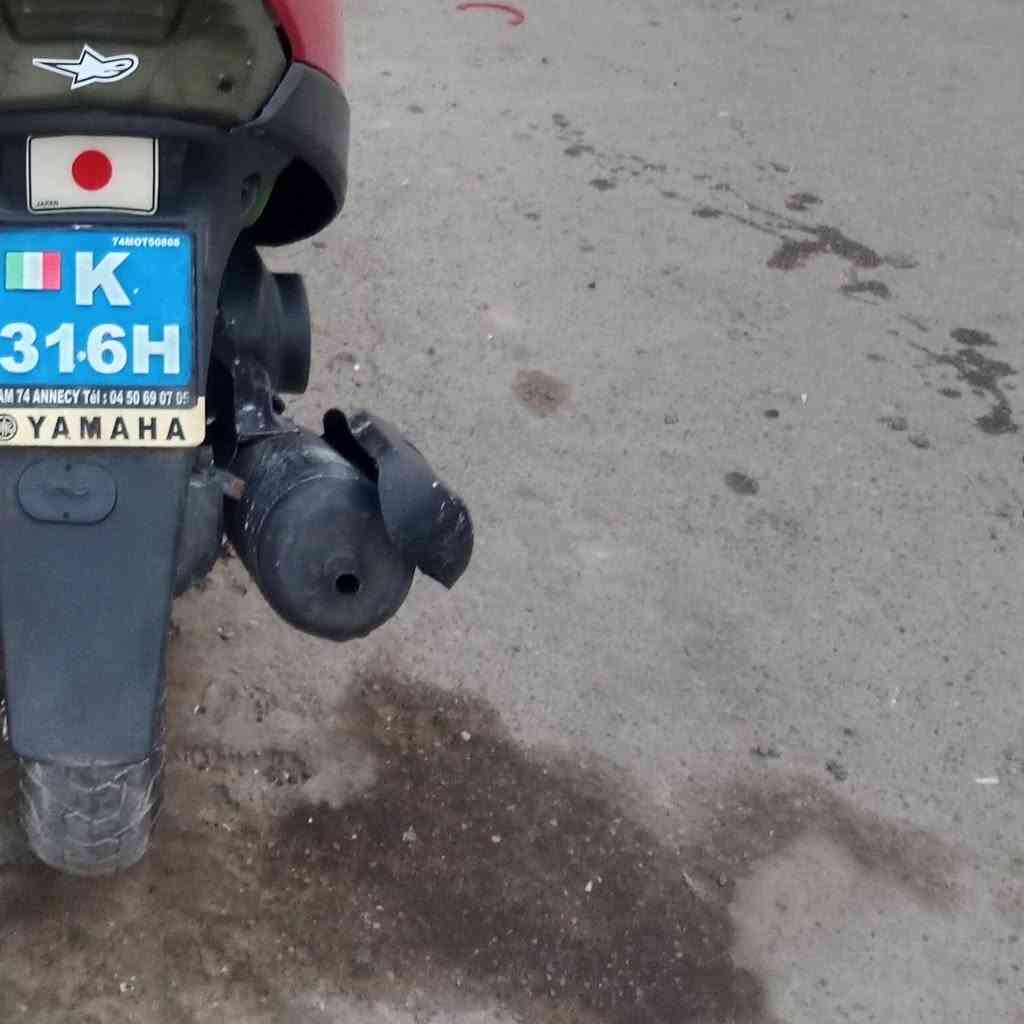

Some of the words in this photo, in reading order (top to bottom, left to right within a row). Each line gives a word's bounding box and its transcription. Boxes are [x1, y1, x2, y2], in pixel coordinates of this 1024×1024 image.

[76, 251, 131, 306] K
[16, 388, 30, 403] 74
[33, 388, 80, 404] ANNECY
[109, 390, 123, 404] 04
[159, 390, 173, 405] 07
[29, 416, 186, 440] YAMAHA
